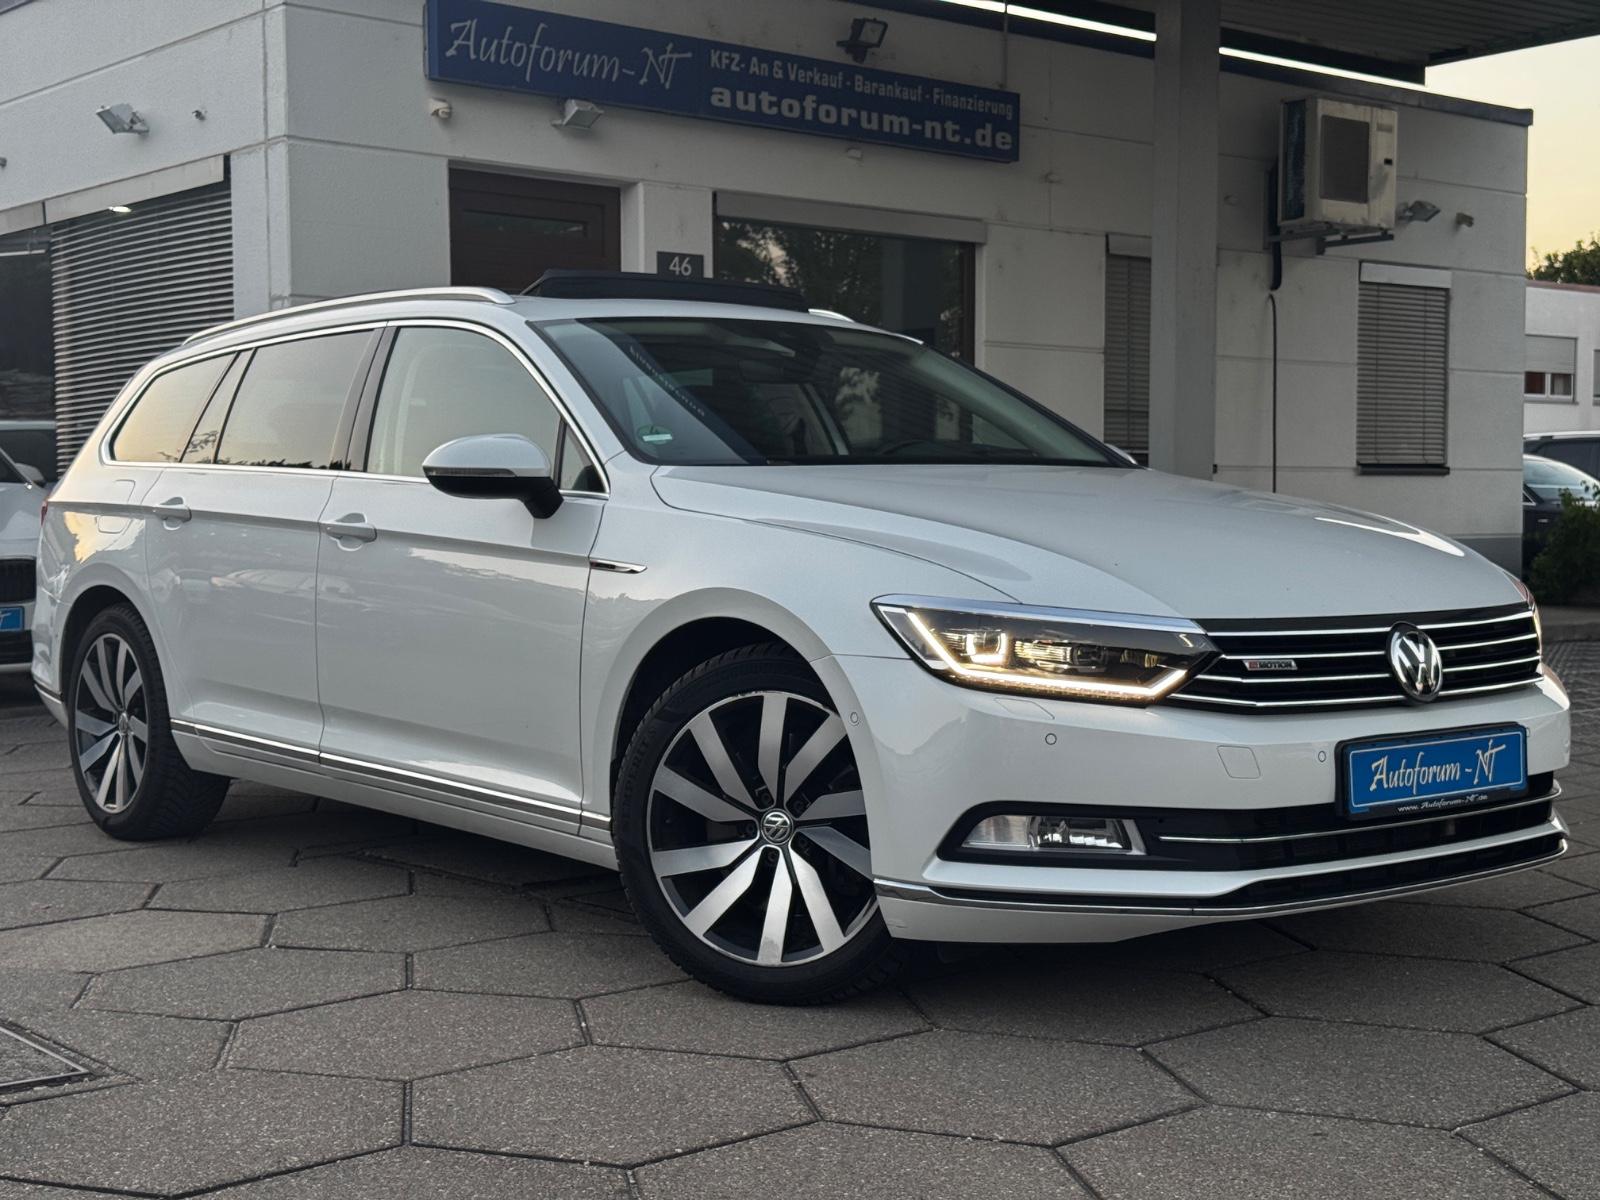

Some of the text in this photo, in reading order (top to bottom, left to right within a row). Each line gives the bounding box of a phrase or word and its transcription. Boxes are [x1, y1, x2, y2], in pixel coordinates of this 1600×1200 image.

[445, 18, 692, 90] Autoforum-NT
[710, 86, 1012, 150] autoforum-nt.de
[749, 56, 769, 76] An
[772, 59, 784, 79] &
[787, 62, 843, 90] Verkauf
[854, 74, 923, 102] Barankauf
[933, 87, 1013, 120] Finanzierung
[668, 256, 692, 276] 46
